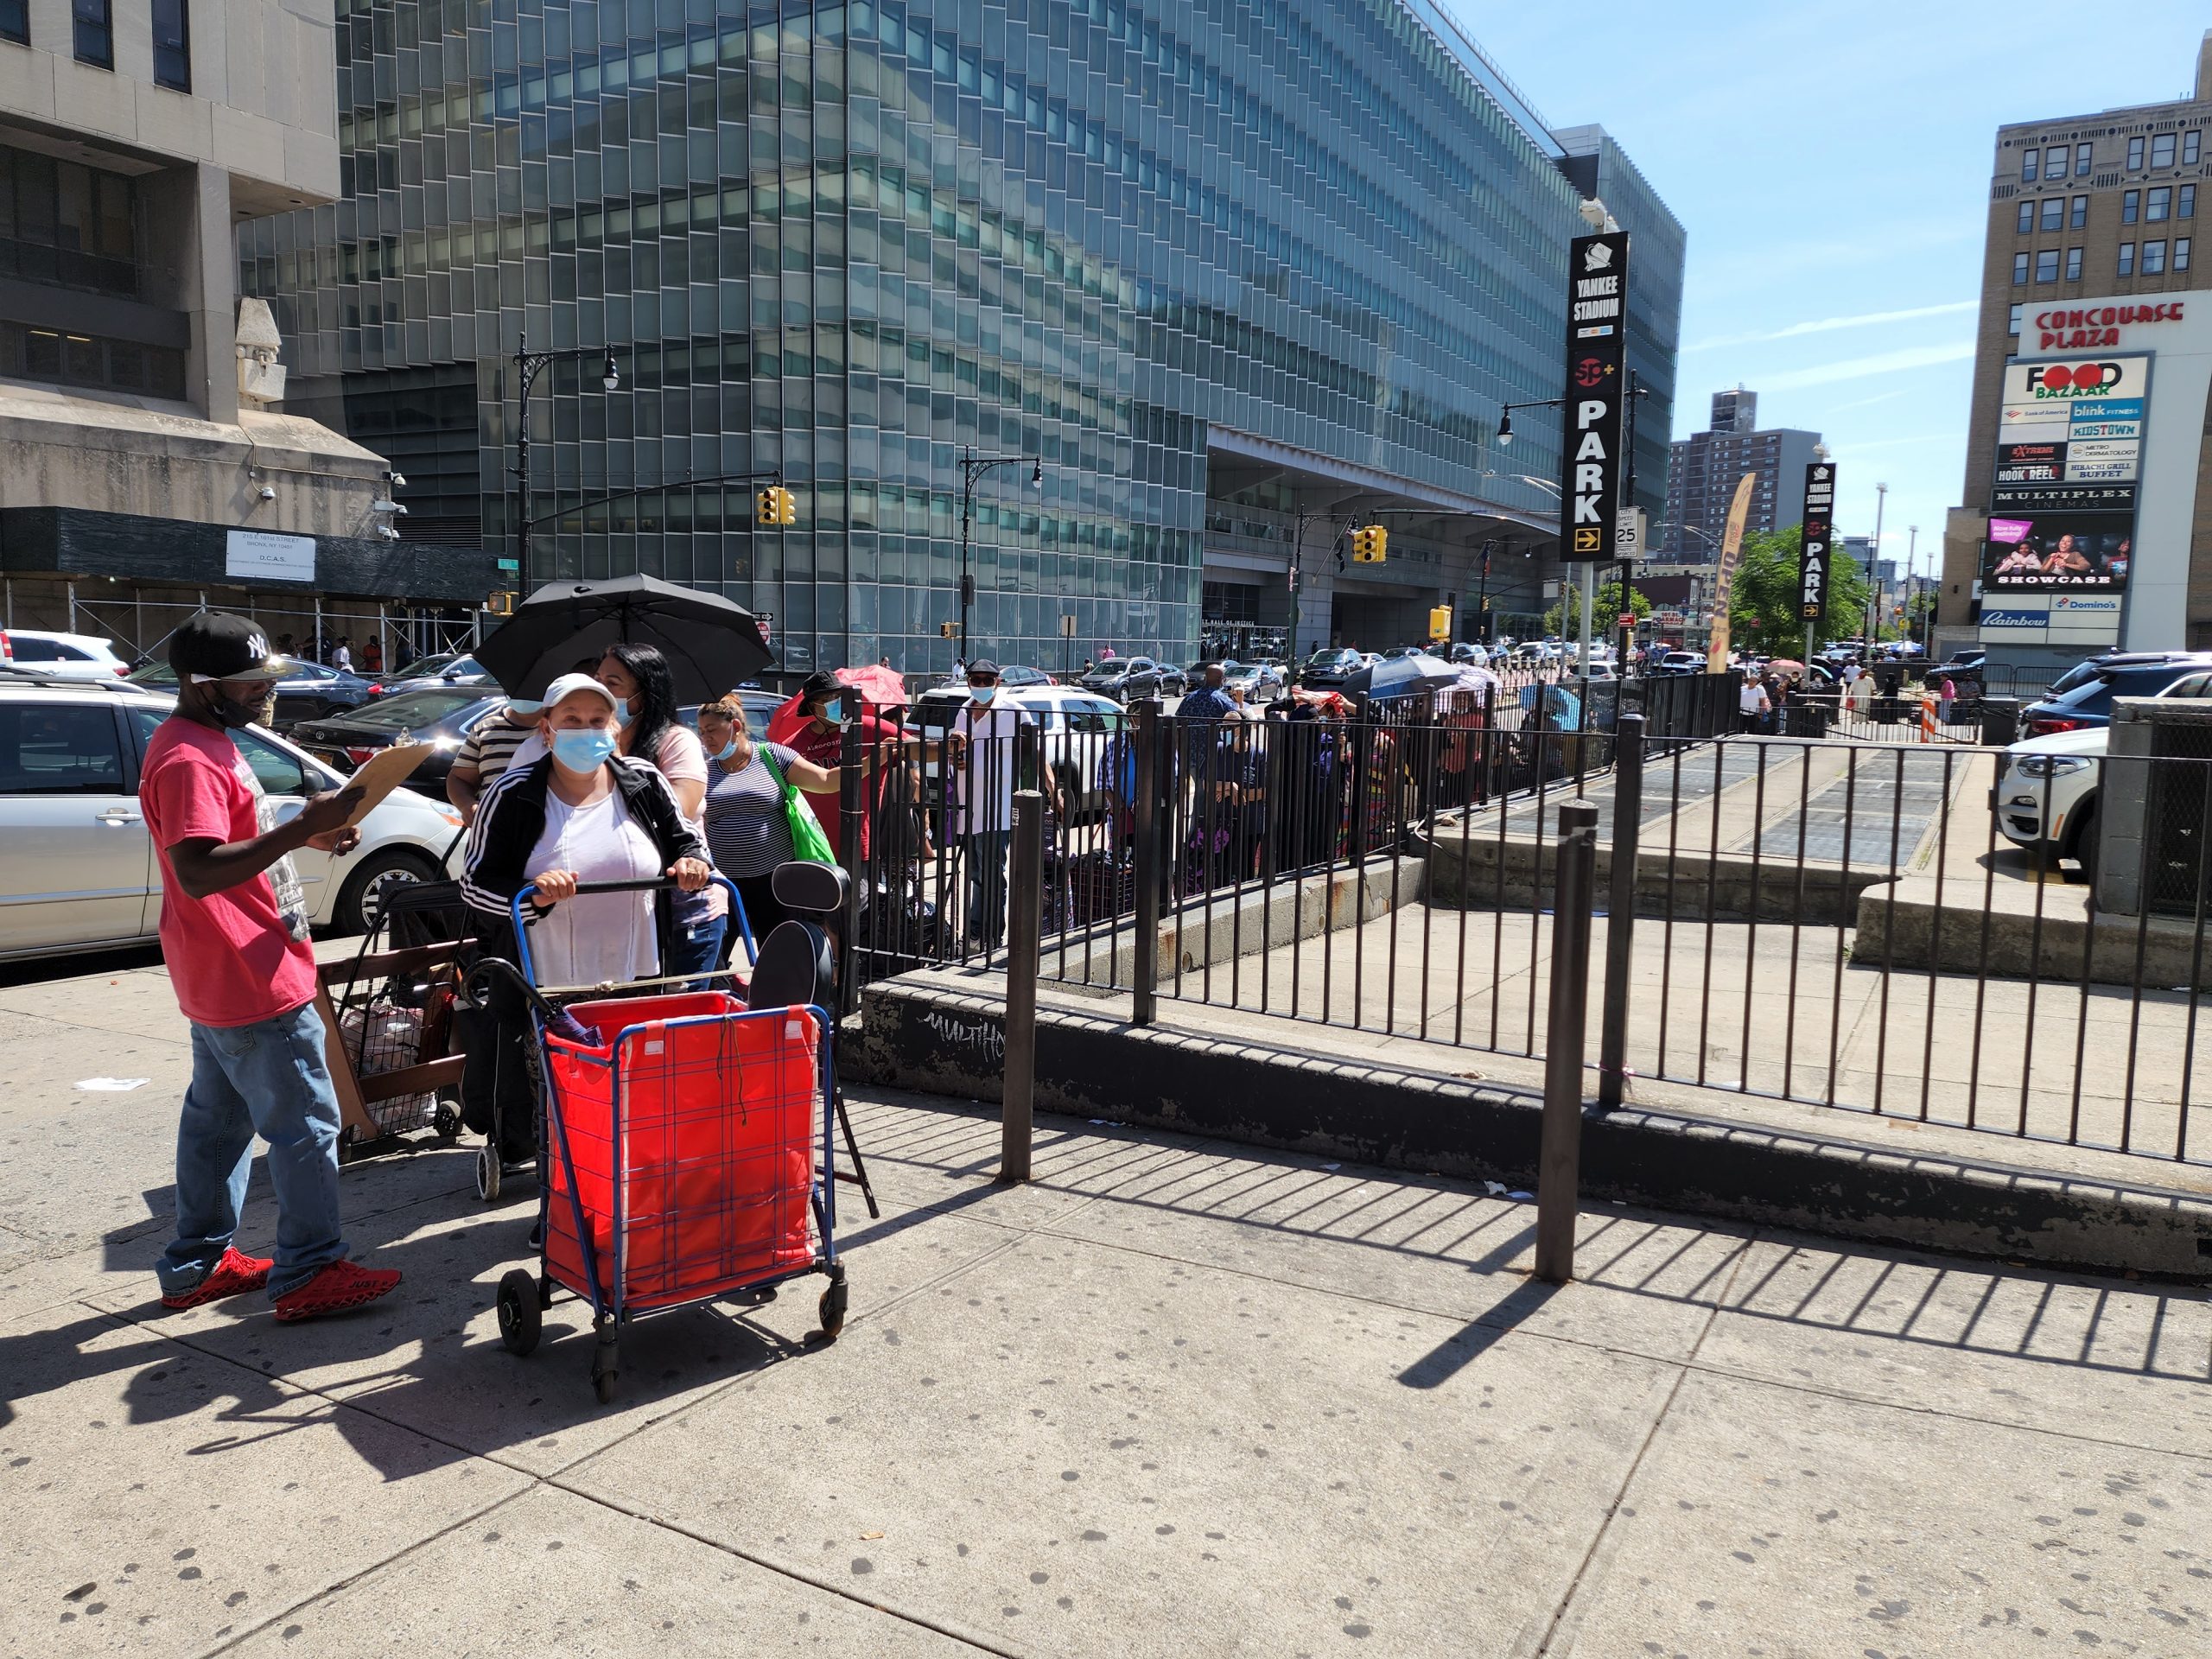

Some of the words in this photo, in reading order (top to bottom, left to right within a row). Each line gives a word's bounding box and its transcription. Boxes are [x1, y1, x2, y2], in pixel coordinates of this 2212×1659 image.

[1577, 275, 1618, 298] YANKEE
[1573, 298, 1619, 321] STADIUM
[2036, 302, 2184, 329] CONCOURSE
[2040, 327, 2120, 350] PLAZA
[2026, 362, 2122, 391] FOOD
[2036, 383, 2110, 399] BAZAAR
[2074, 404, 2105, 416] blink
[2074, 424, 2135, 436] KIDSTOWN
[1574, 400, 1607, 524] PARK
[1998, 470, 2024, 481] HOOK
[2029, 468, 2056, 480] REEL
[1809, 483, 1832, 493] YANKEE
[1996, 489, 2133, 500] MULTIPLEX
[1807, 493, 1832, 504] STADIUM
[2024, 499, 2101, 509] CINEMAS
[1617, 528, 1636, 543] 25
[1803, 543, 1823, 603] PARK
[1714, 550, 1736, 618] OPEN
[2070, 601, 2116, 609] Domino's
[1982, 611, 2047, 626] Rainbow
[247, 633, 267, 658] NY
